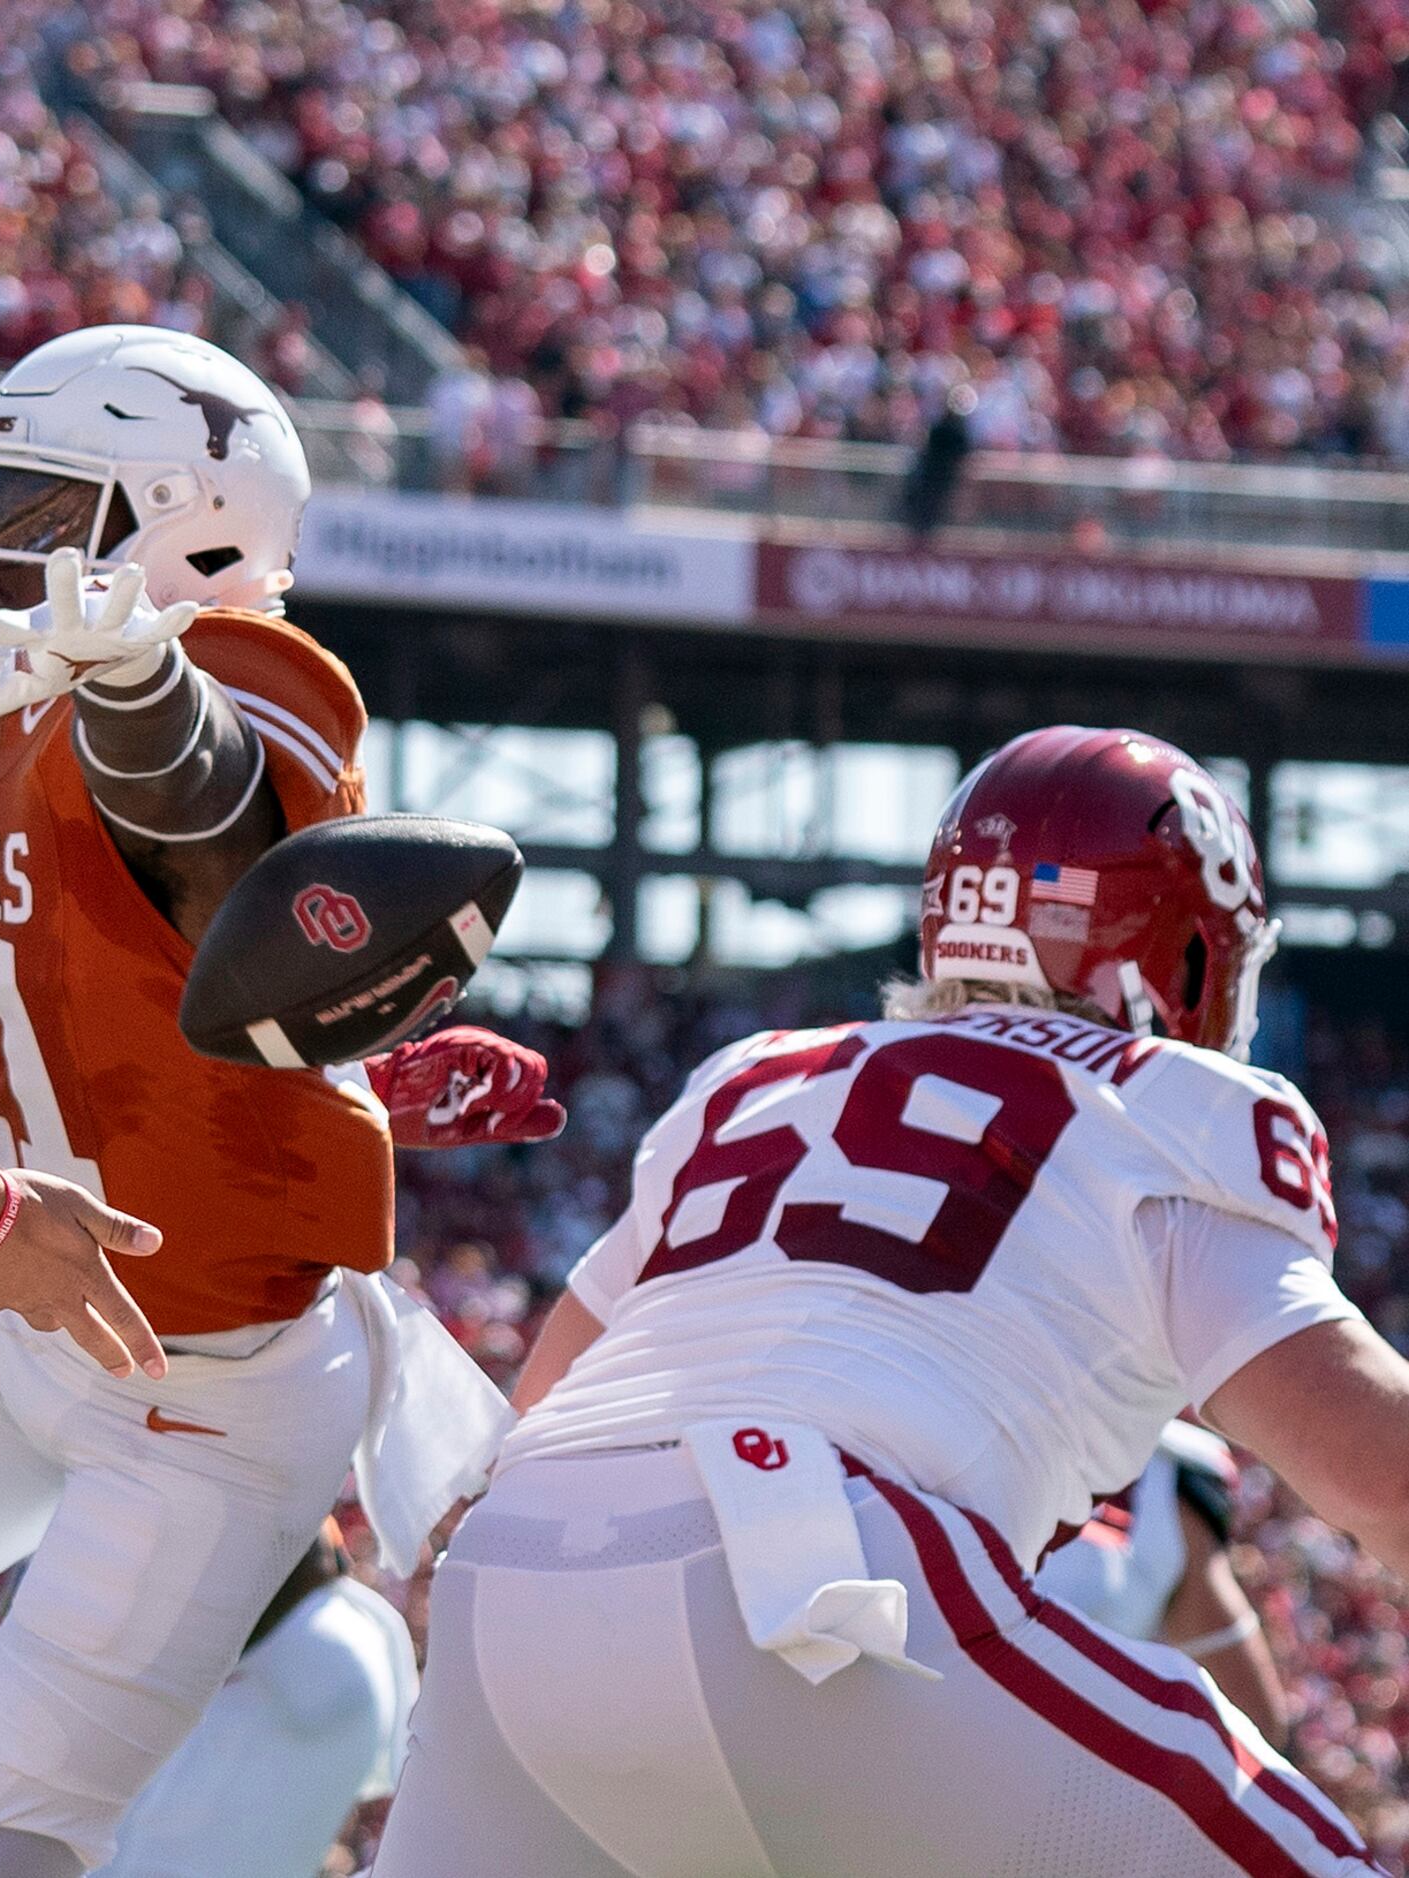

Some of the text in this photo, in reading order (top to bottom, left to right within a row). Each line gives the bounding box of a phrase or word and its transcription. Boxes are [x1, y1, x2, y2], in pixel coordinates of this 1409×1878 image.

[293, 883, 372, 953] OU
[949, 865, 1020, 926] 69
[635, 1031, 1078, 1294] 69
[732, 1427, 789, 1472] OU
